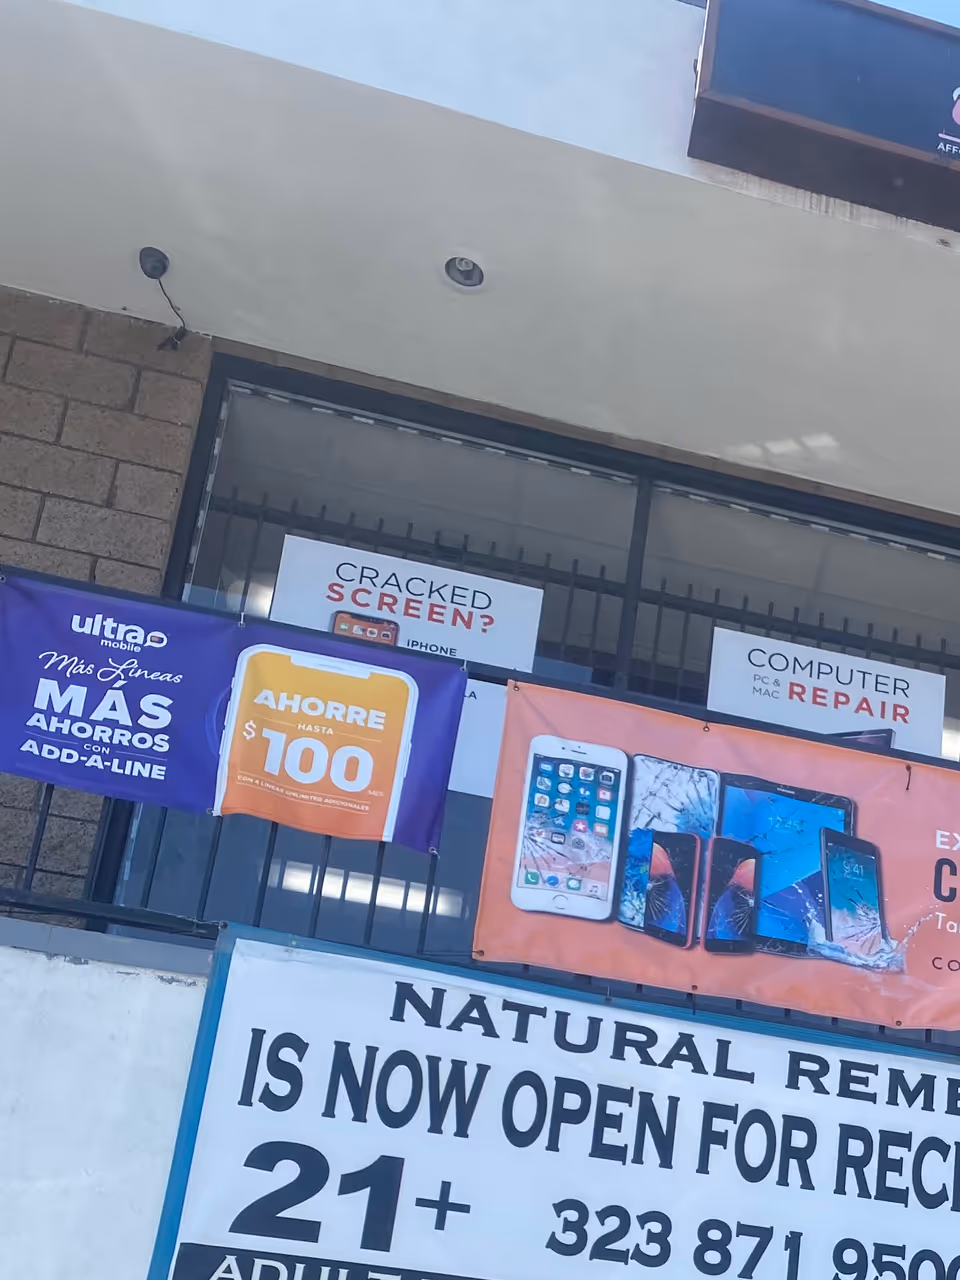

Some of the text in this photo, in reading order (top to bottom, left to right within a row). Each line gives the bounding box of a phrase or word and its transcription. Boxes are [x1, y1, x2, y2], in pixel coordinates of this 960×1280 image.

[335, 562, 492, 610] CRACKED
[326, 582, 495, 633] SCREEN?
[71, 614, 145, 645] ultra
[100, 638, 142, 653] mobile
[406, 639, 457, 657] IPHONE
[38, 651, 95, 678] Más
[747, 648, 910, 699] COMPUTER
[753, 674, 781, 687] PC &
[33, 678, 174, 730] MÁS
[254, 689, 387, 730] AHORRE
[752, 686, 780, 699] MAC
[788, 681, 910, 724] REPAIR
[25, 712, 170, 753] AHORROS
[83, 743, 110, 755] CON
[297, 722, 334, 735] HASTA
[20, 739, 167, 781] ADD-A-LINE
[390, 981, 756, 1085] NATURAL
[237, 1028, 310, 1112] IS
[321, 1040, 491, 1138] NOW
[502, 1070, 681, 1170] OPEN
[696, 1101, 817, 1191] FOR
[545, 1197, 673, 1269] 323
